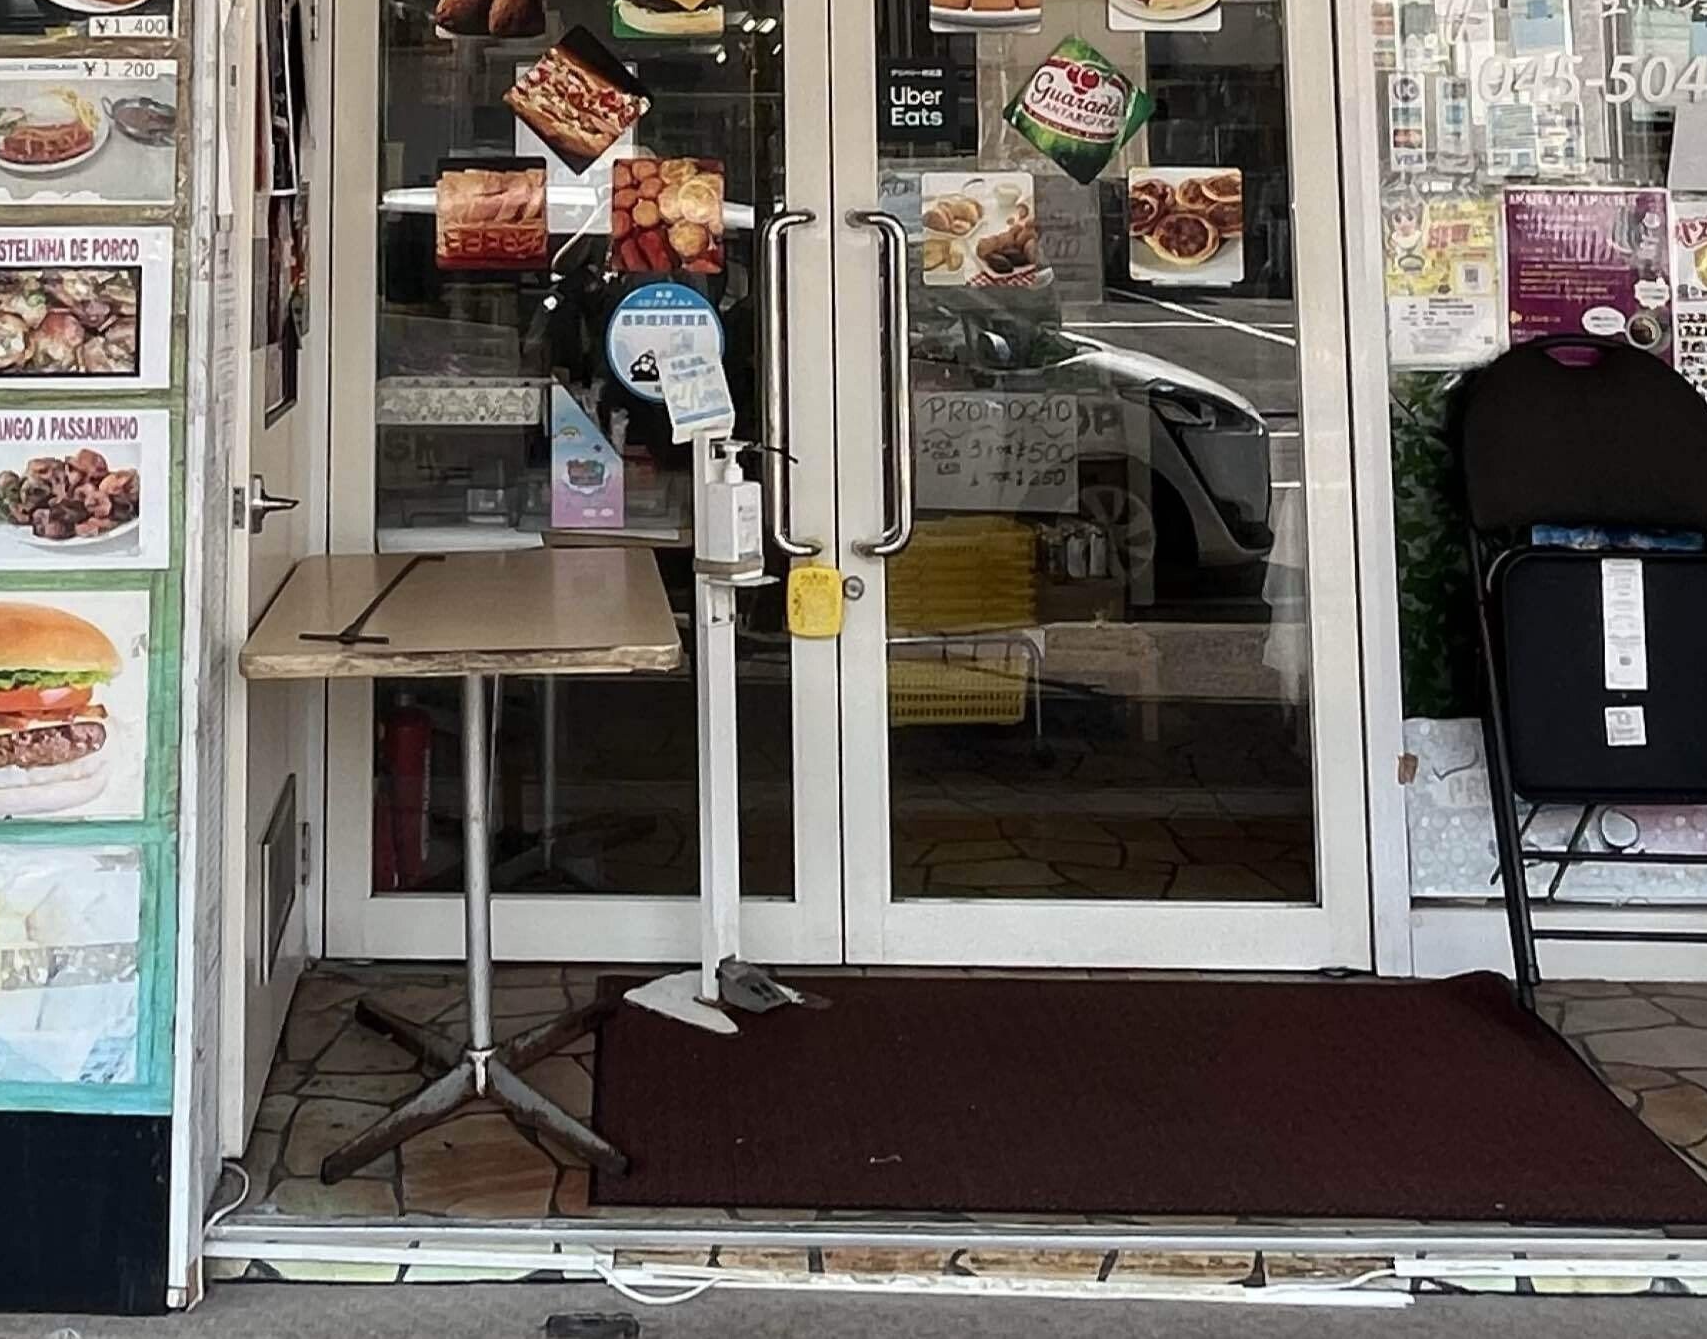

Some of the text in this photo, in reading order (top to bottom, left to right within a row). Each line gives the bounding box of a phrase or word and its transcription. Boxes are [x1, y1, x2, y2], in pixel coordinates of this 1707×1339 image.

[889, 85, 943, 106] Uber
[890, 107, 943, 127] Eats
[70, 237, 88, 264] DE
[91, 236, 140, 264] PORCO
[37, 415, 47, 441] A
[51, 415, 139, 441] PASSARINHO
